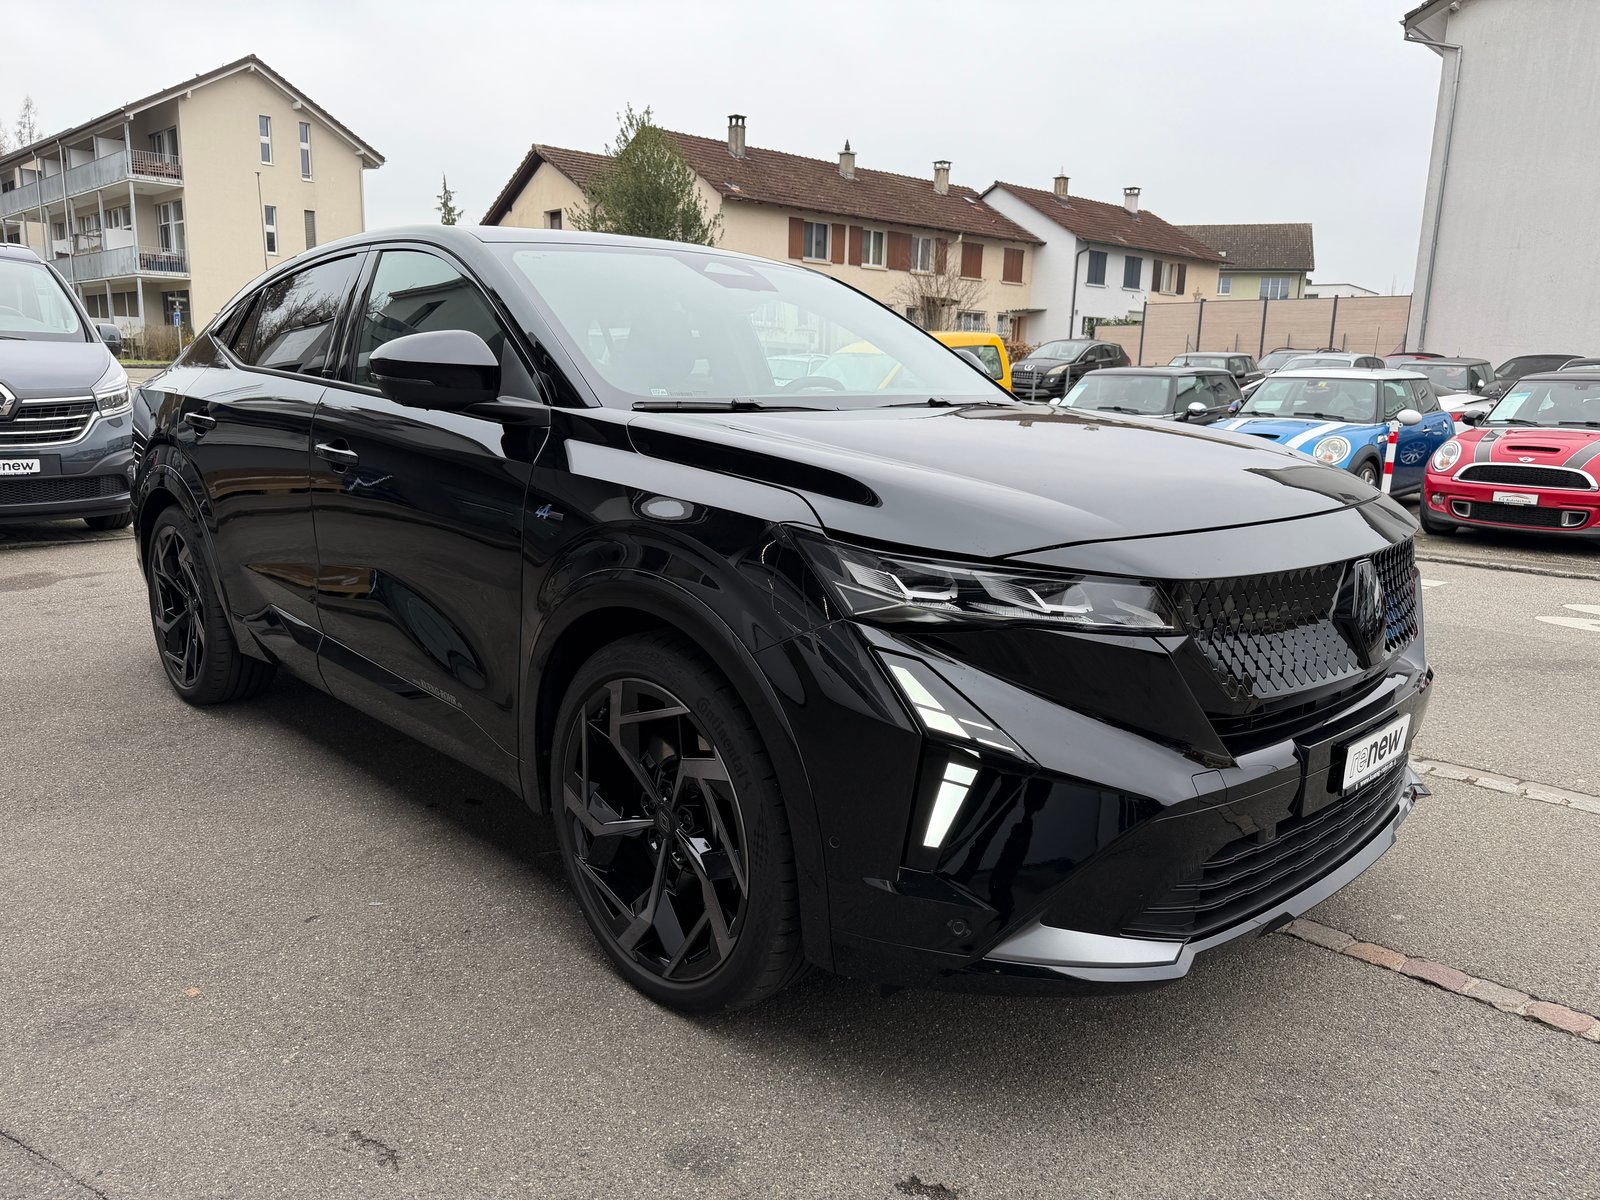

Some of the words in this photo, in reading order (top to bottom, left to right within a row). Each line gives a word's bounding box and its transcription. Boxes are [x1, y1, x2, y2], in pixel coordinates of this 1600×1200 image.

[0, 462, 34, 471] new
[696, 697, 748, 778] Continental
[1349, 726, 1403, 778] renew
